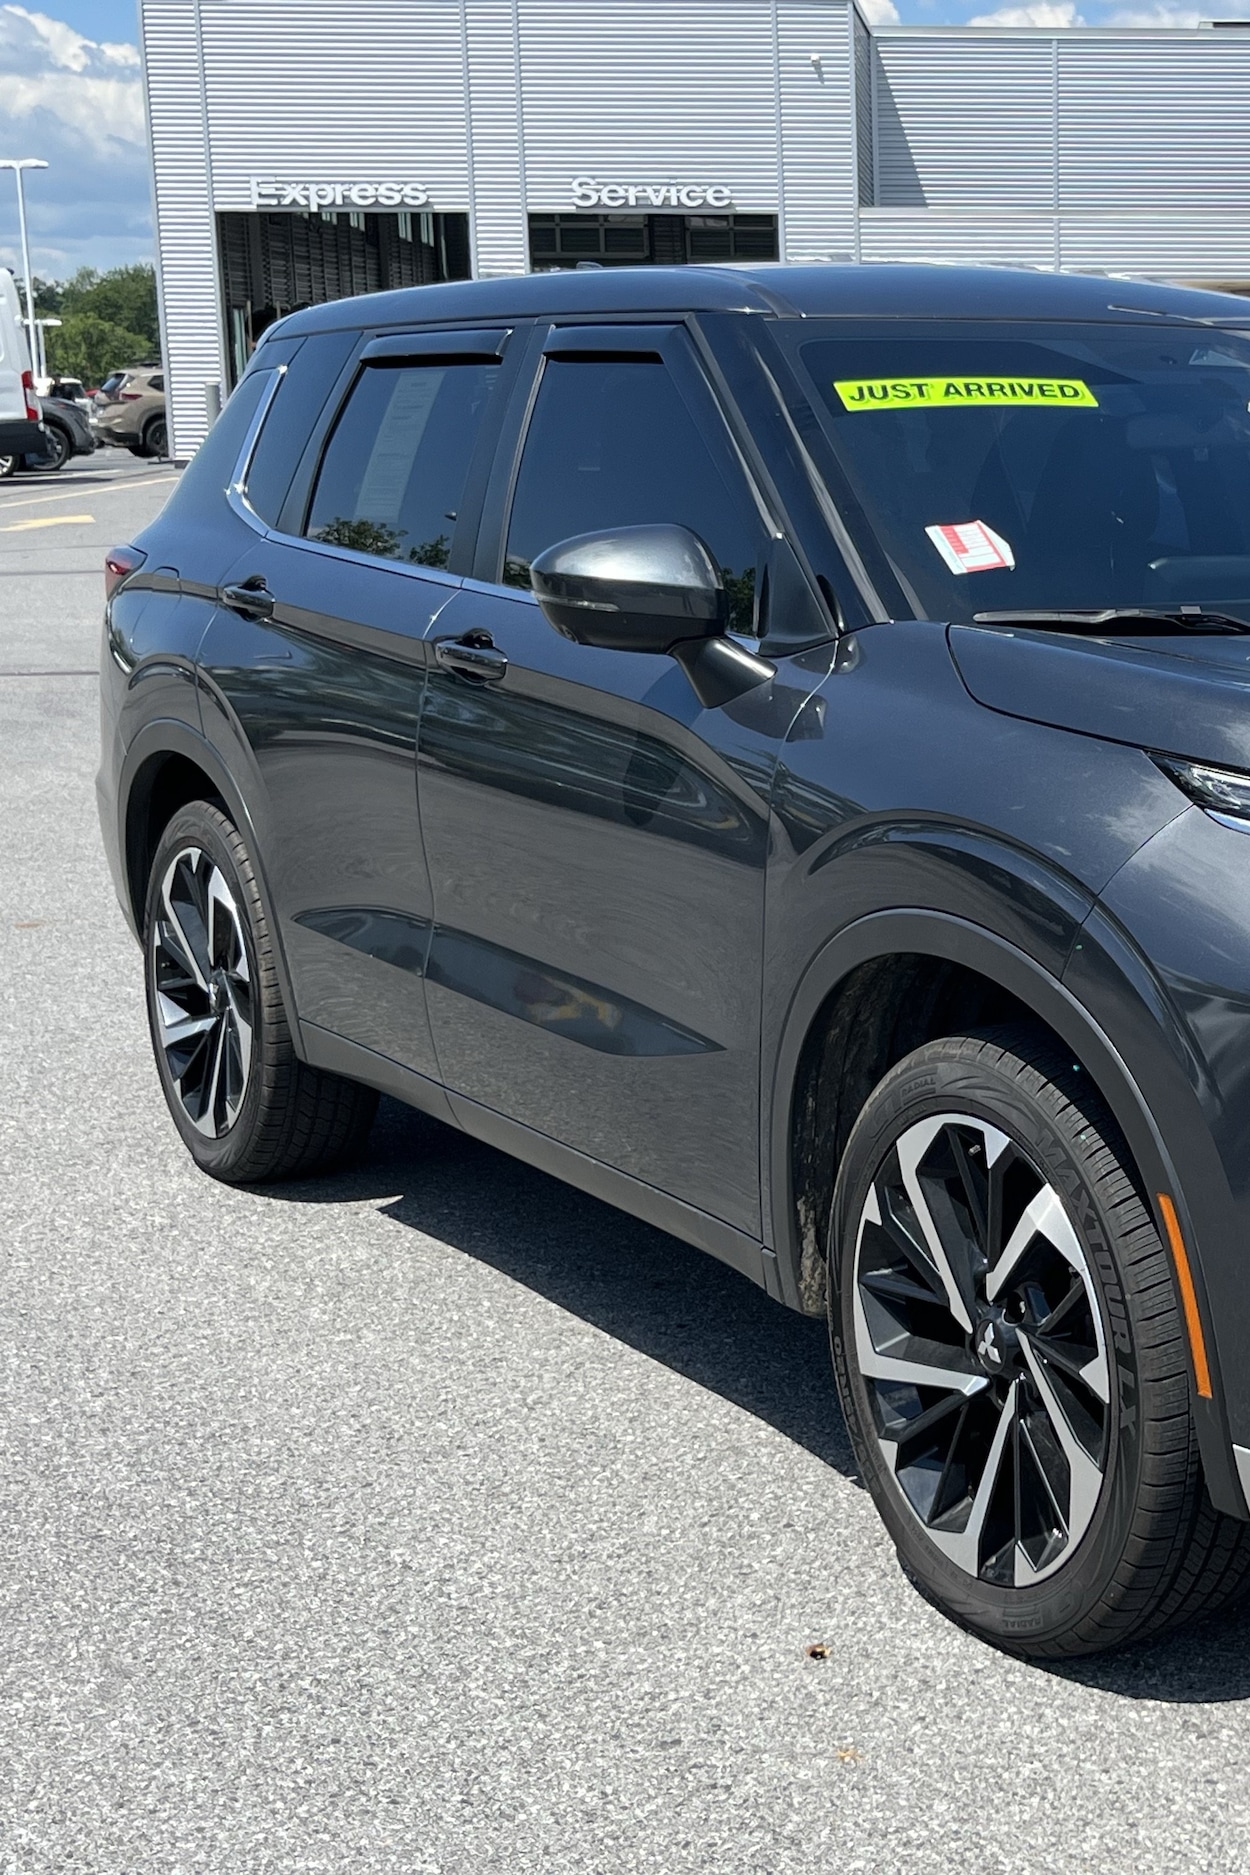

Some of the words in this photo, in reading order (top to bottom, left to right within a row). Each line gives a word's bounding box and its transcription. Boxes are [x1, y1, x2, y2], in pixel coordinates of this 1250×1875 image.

[250, 176, 428, 212] Express
[571, 177, 732, 207] Service
[850, 383, 930, 402] JUST
[943, 382, 1081, 399] ARRIVED
[901, 1077, 936, 1097] RADIAL
[1036, 1127, 1132, 1353] MAXTOUR
[1117, 1364, 1138, 1440] LX
